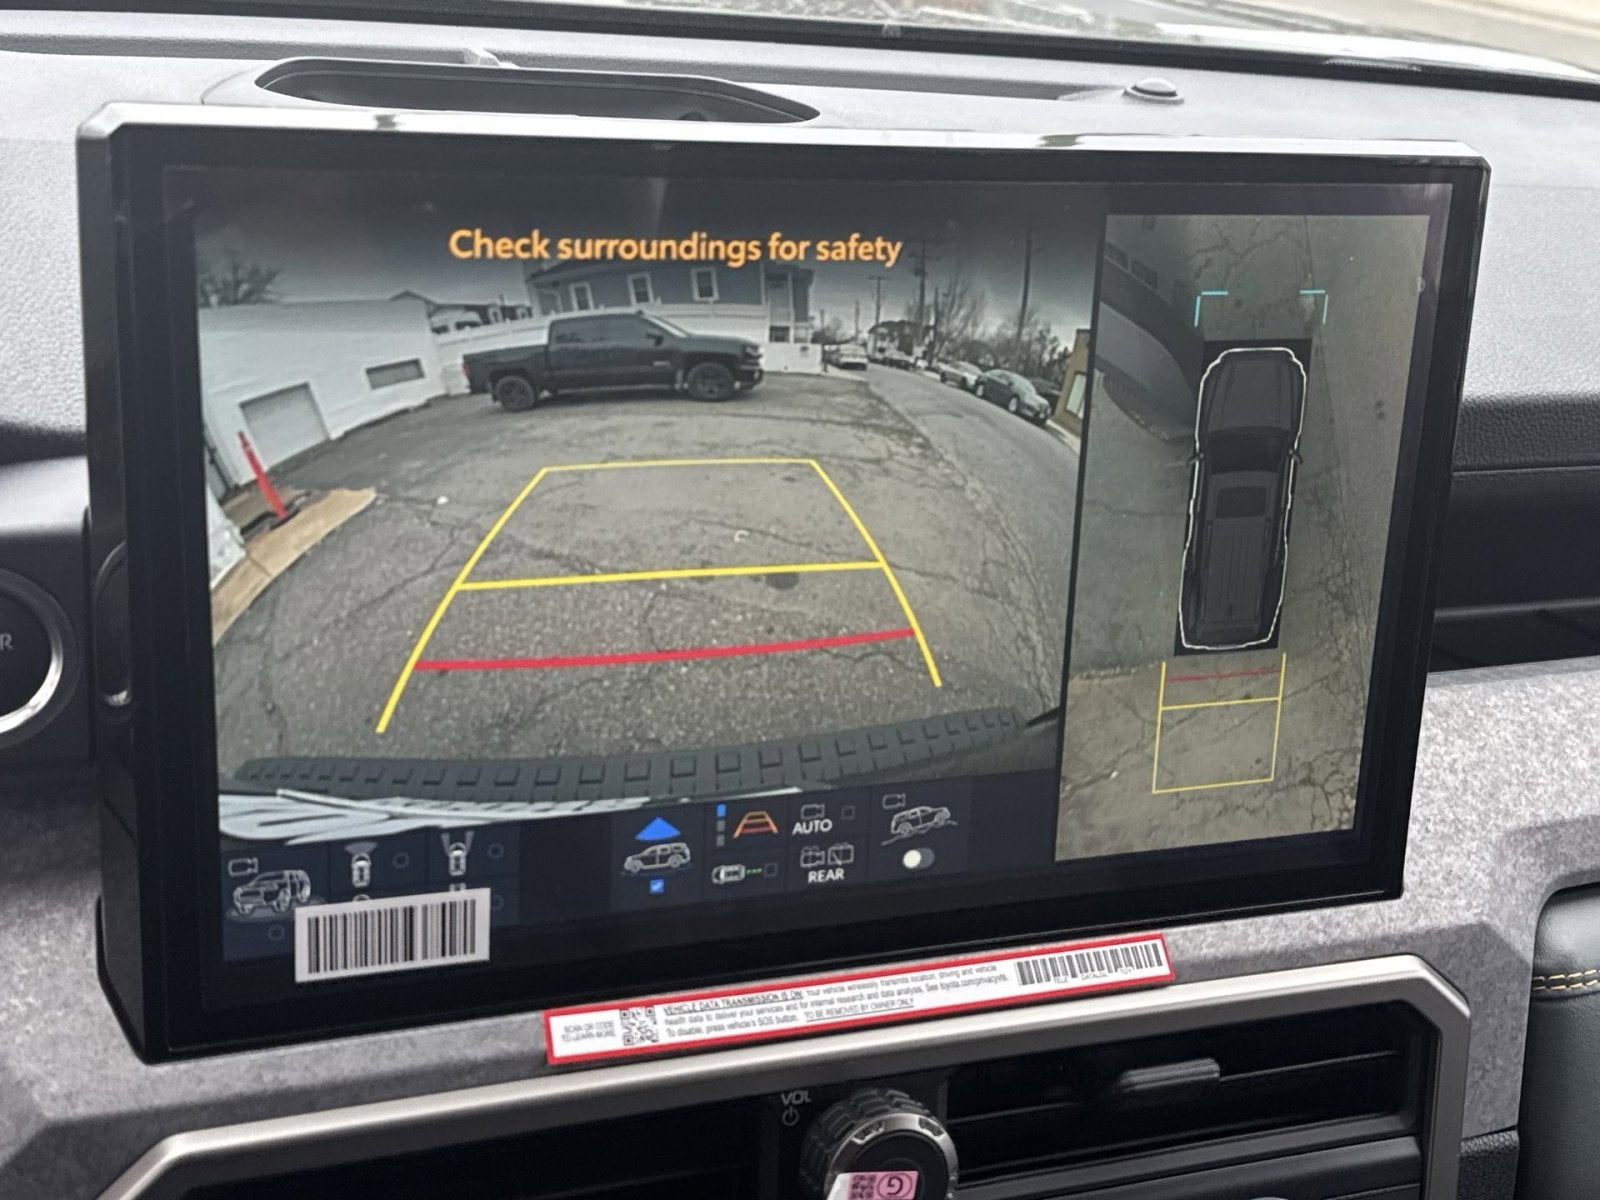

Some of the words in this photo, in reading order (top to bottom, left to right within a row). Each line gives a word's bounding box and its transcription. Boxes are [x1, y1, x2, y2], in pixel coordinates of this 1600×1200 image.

[448, 229, 550, 259] Check
[557, 232, 761, 267] surroundings
[768, 232, 811, 260] for
[816, 233, 902, 267] safety
[792, 819, 833, 836] AUTO
[808, 869, 845, 884] REAR
[664, 1002, 696, 1015] VEHICLE
[699, 1000, 719, 1011] DATA
[721, 992, 779, 1006] TRANSMISSION
[758, 1016, 774, 1027] SOS
[870, 999, 896, 1010] OWNER
[897, 997, 914, 1007] ONLY
[781, 1090, 811, 1105] VOL
